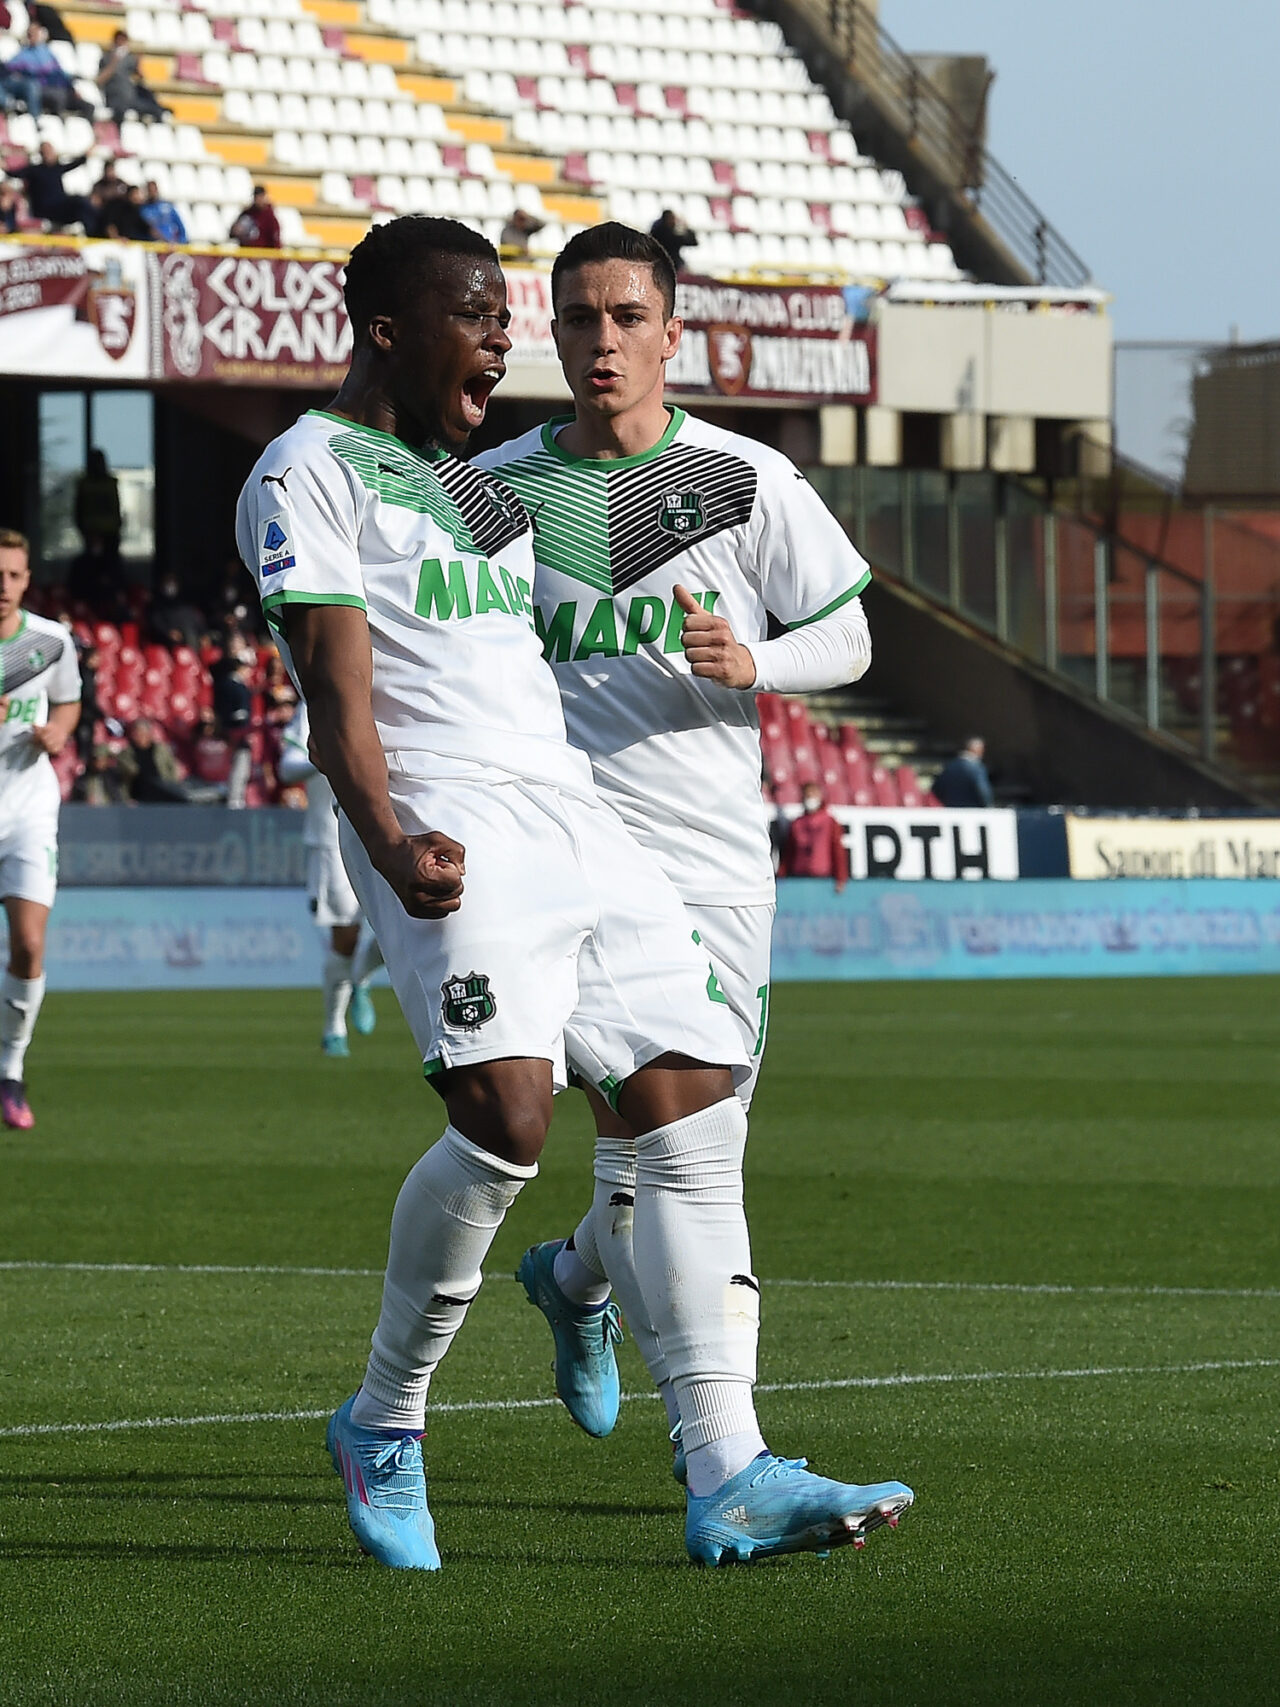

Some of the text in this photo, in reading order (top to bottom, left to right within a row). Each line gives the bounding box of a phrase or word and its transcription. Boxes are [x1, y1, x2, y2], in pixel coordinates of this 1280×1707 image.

[263, 549, 290, 563] SERIE A
[840, 824, 990, 880] RTH
